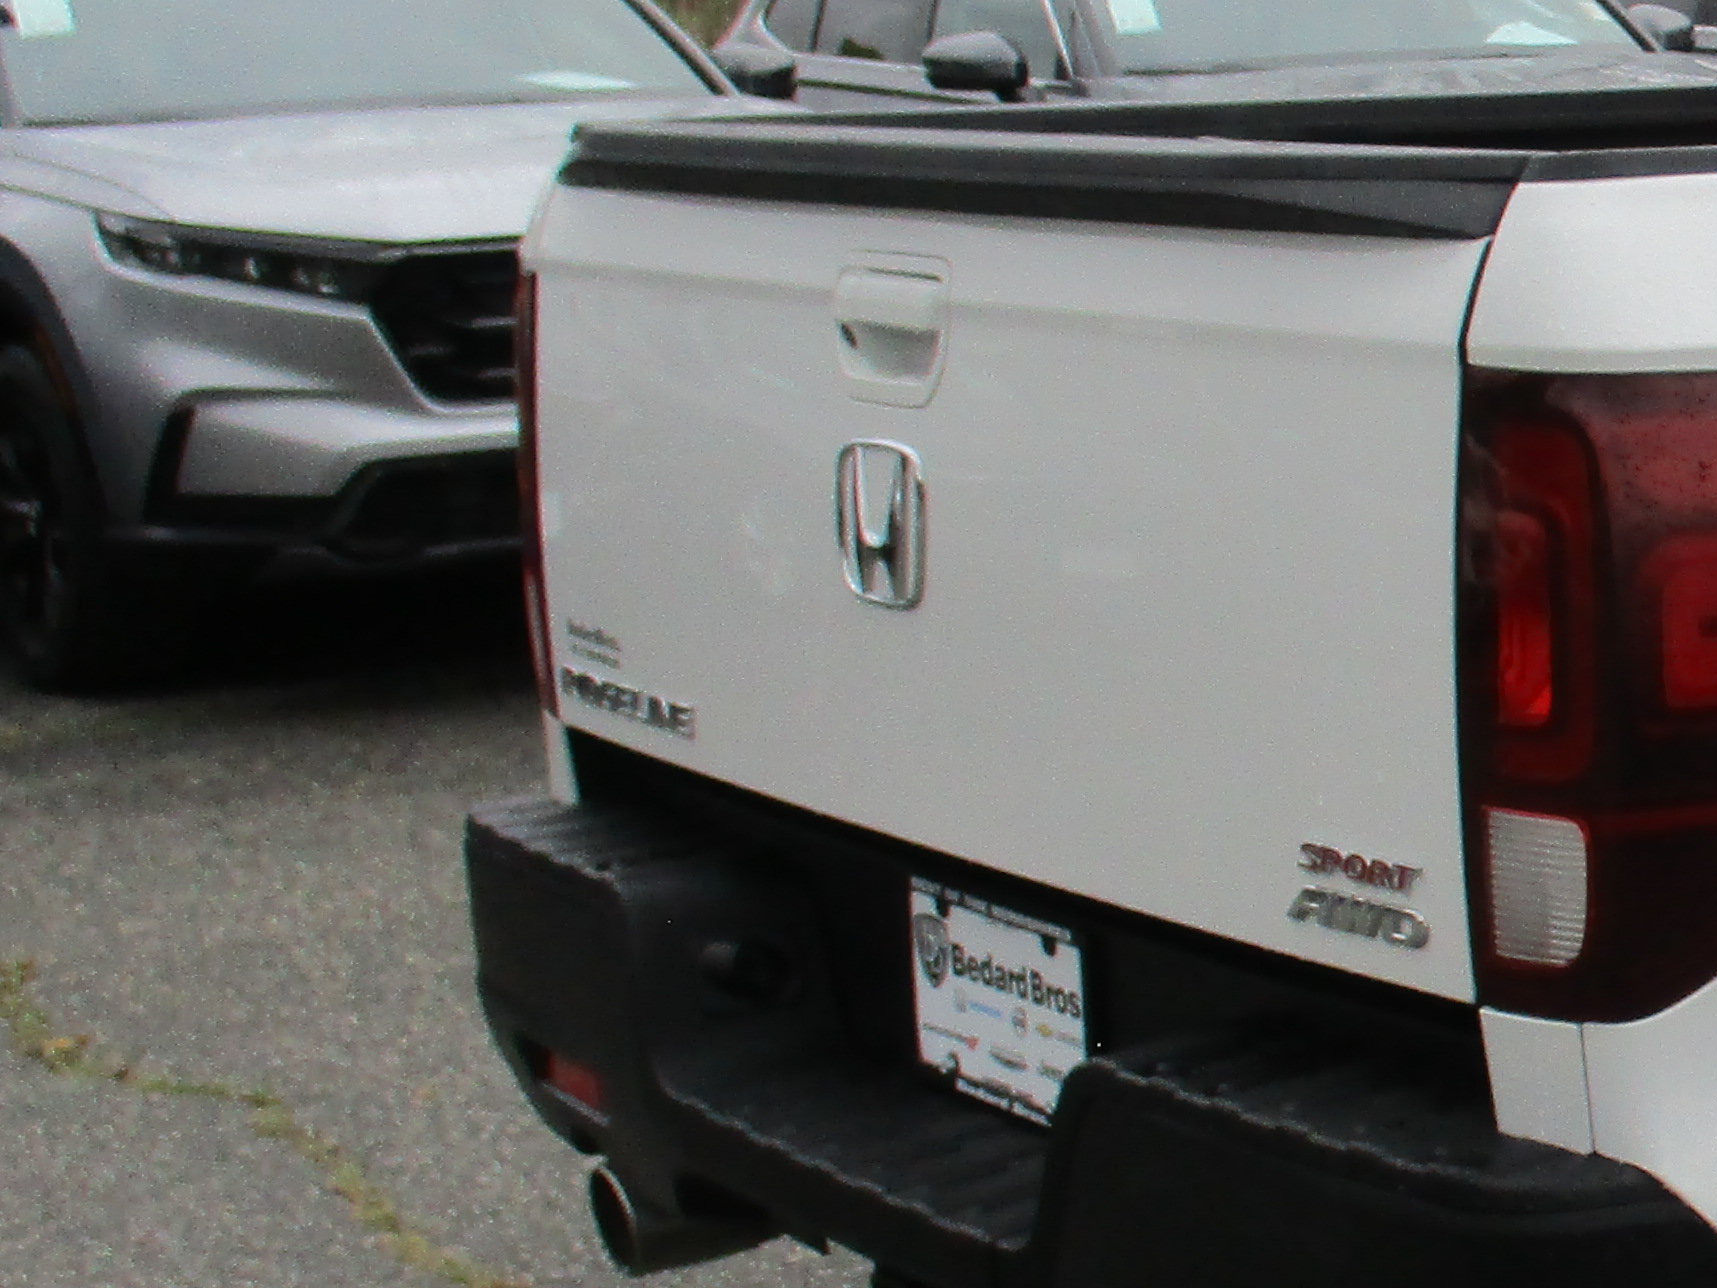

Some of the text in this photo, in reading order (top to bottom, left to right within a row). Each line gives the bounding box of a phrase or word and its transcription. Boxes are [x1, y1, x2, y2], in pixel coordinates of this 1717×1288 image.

[1297, 842, 1424, 892] SPORT
[1287, 887, 1431, 949] AWD
[951, 942, 1081, 1019] Bedard Bros
